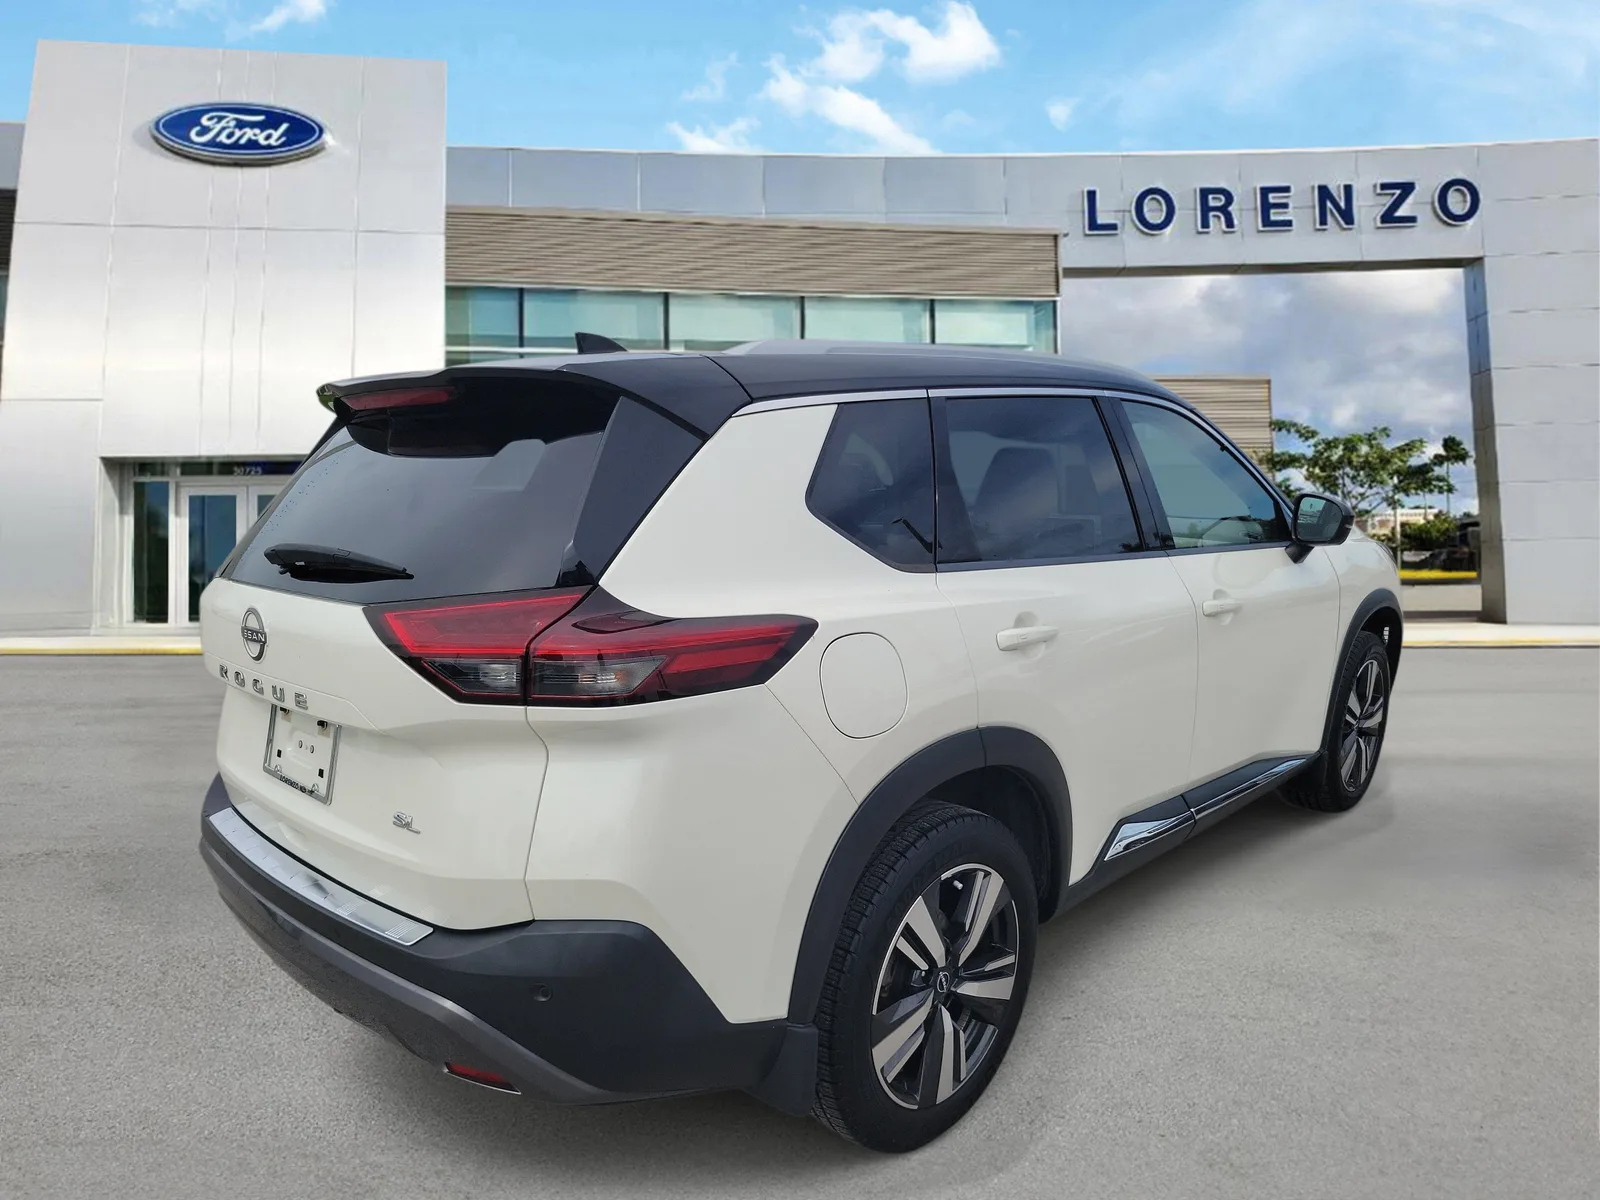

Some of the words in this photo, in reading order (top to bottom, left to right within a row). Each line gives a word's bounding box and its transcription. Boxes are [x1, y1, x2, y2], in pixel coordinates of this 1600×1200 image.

[189, 111, 290, 146] Ford
[1083, 177, 1481, 235] LORENZO
[219, 663, 309, 711] ROGUE
[392, 811, 421, 834] SL
